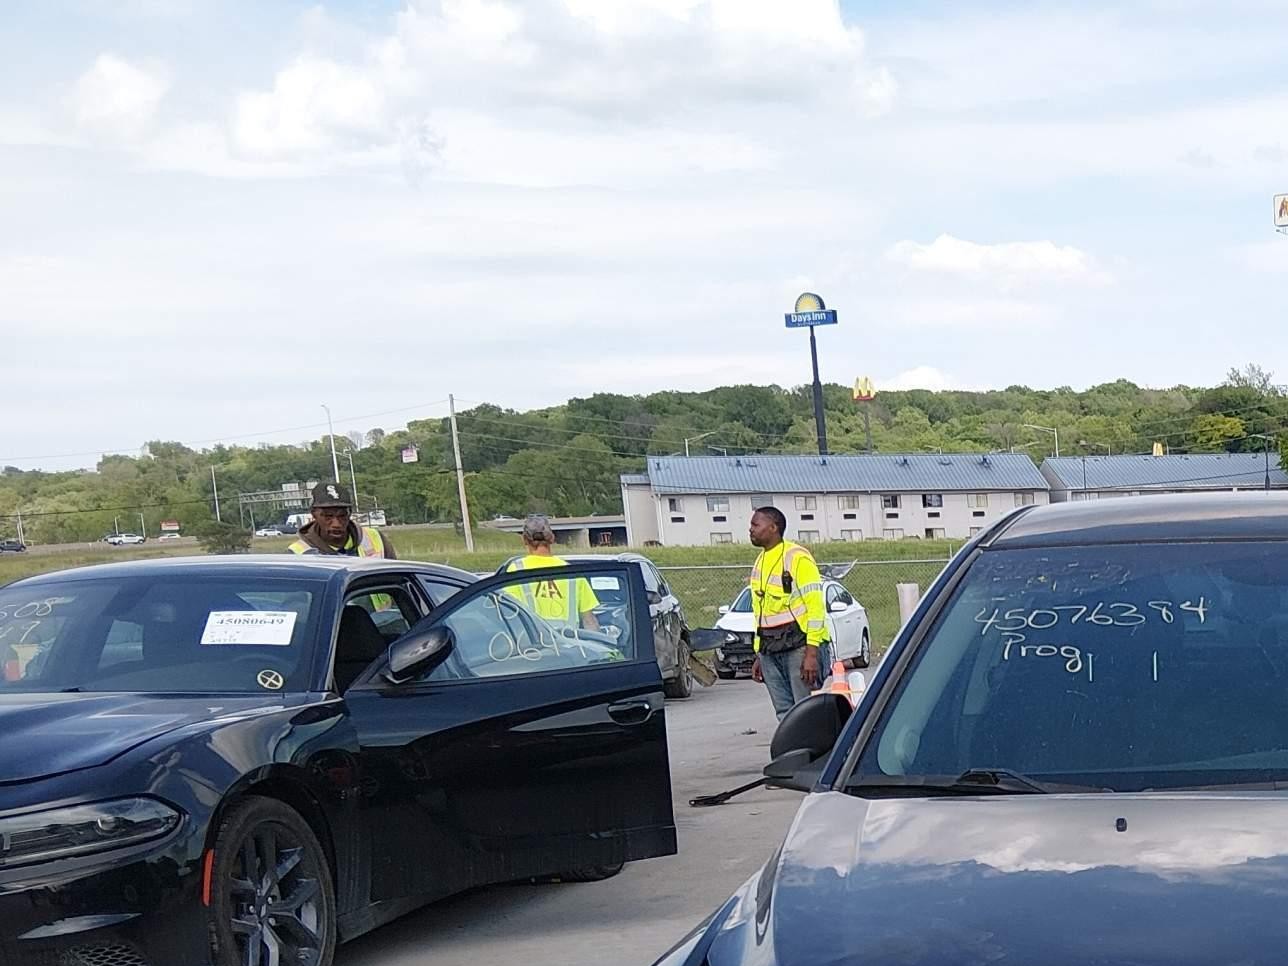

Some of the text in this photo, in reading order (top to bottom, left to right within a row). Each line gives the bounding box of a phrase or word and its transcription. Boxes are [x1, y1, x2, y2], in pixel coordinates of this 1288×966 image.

[791, 311, 826, 323] Days Inn
[216, 617, 284, 625] 45080649
[974, 596, 1208, 635] 45076384
[1000, 631, 1082, 673] Prog
